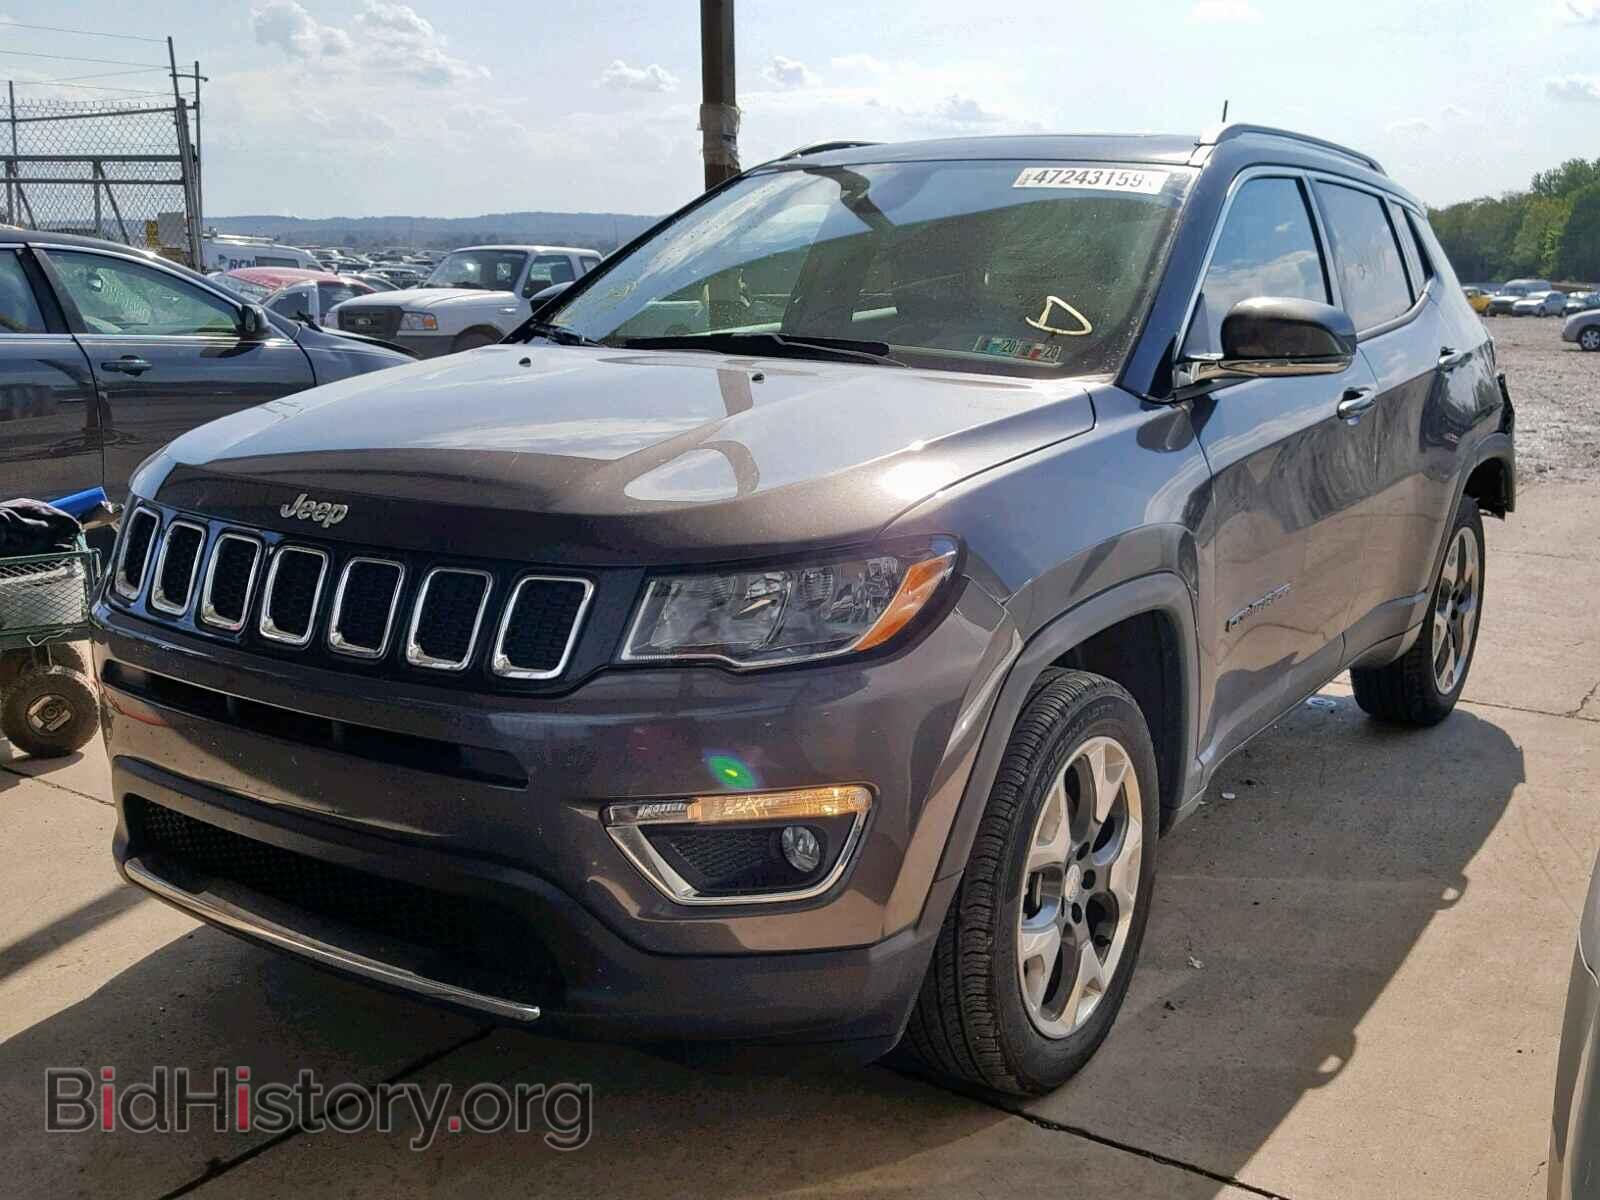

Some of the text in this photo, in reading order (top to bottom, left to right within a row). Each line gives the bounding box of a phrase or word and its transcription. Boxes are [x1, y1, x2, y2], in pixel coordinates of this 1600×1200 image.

[1002, 339, 1017, 353] 20
[1044, 344, 1059, 359] 20
[280, 493, 348, 528] Jeep
